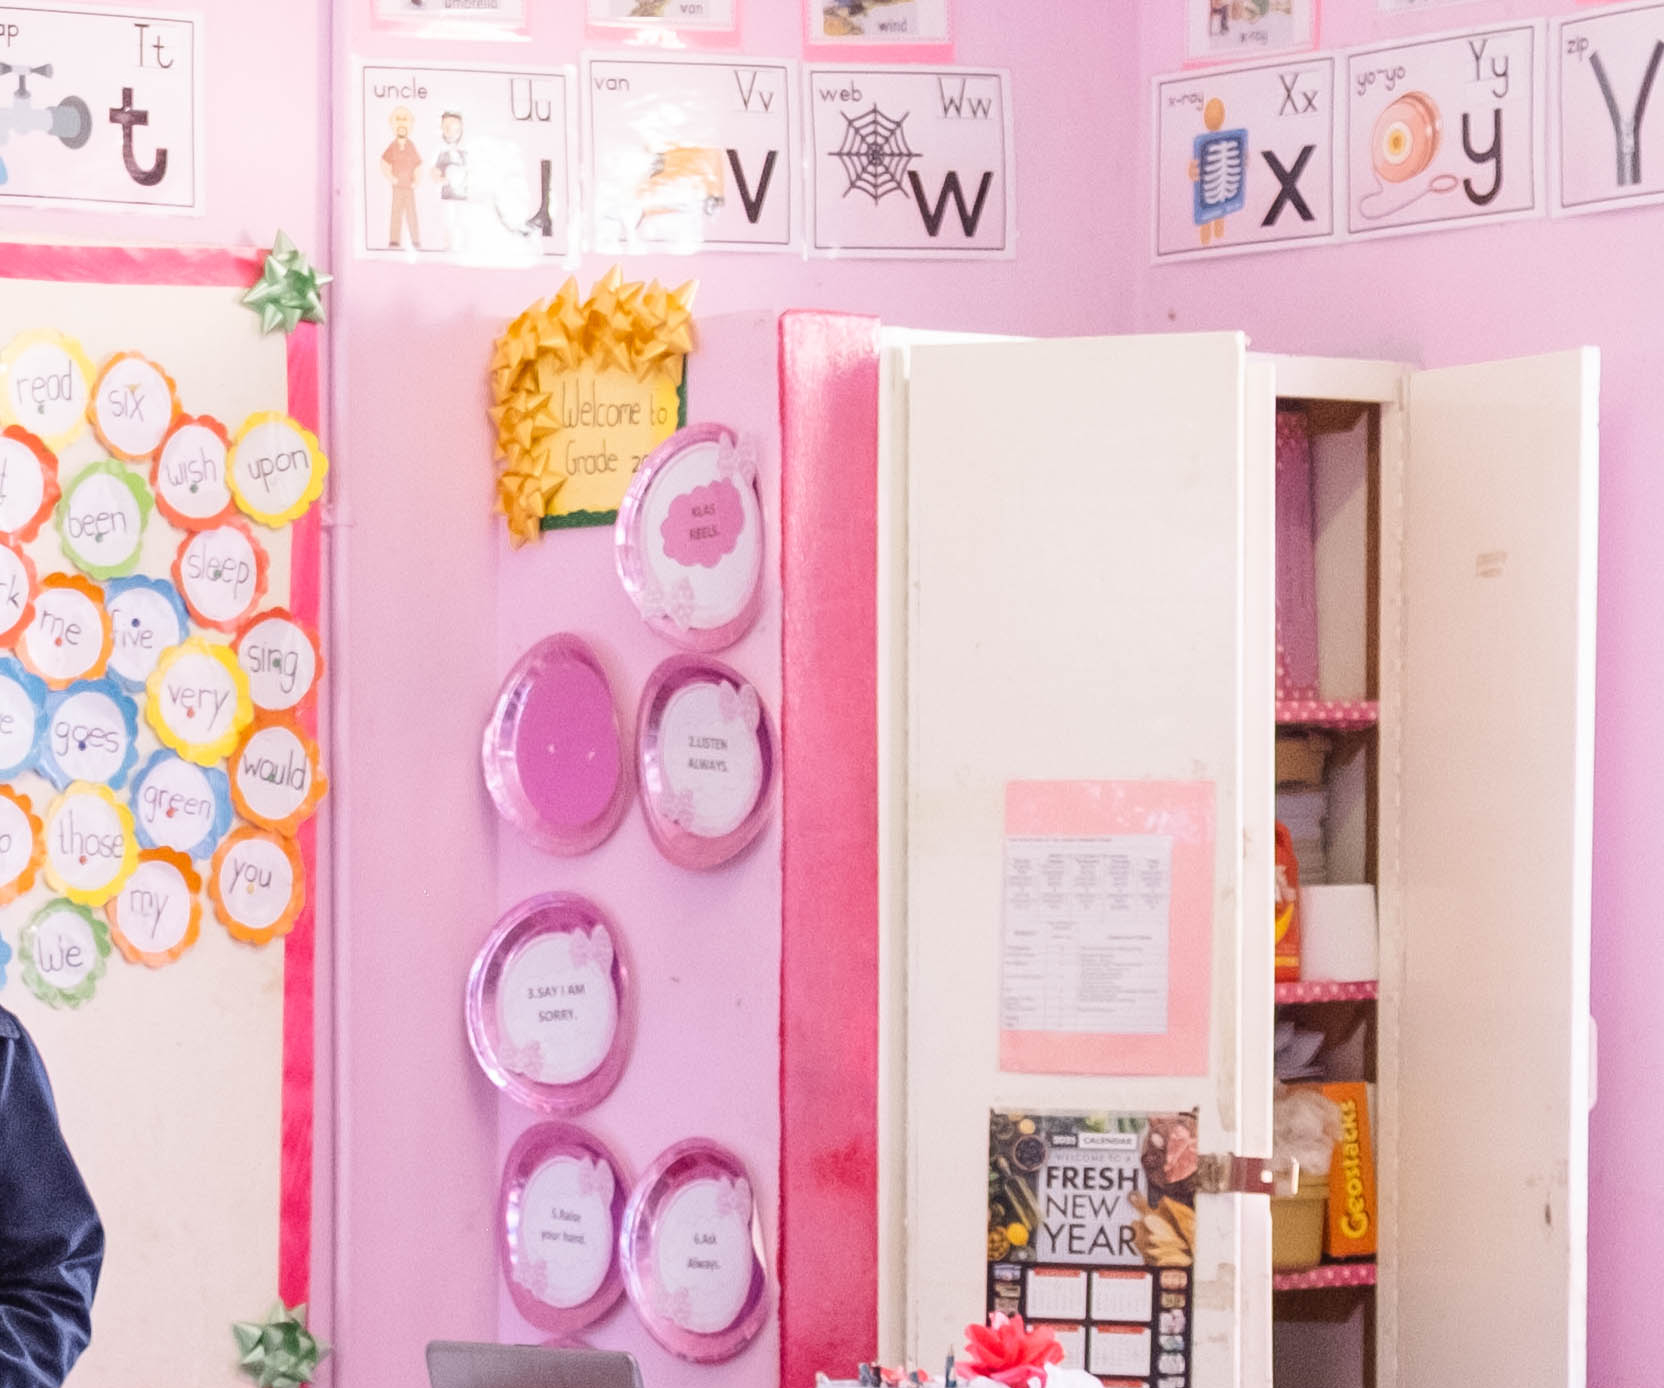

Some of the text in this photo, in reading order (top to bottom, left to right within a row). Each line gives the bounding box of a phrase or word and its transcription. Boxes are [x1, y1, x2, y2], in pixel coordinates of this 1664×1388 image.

[877, 17, 909, 34] wind
[134, 23, 174, 69] Tt
[1567, 35, 1590, 61] zip
[593, 74, 631, 92] van
[1356, 64, 1407, 96] yo-yo
[1470, 39, 1510, 98] Yy
[373, 81, 428, 101] uncle
[509, 77, 553, 123] Uu
[733, 70, 775, 113] Vv
[819, 82, 863, 103] web
[937, 76, 993, 120] Ww
[1279, 72, 1319, 117] Xx
[108, 86, 168, 186] t
[1462, 107, 1504, 206] y
[16, 360, 72, 404] read
[108, 389, 146, 422] six
[561, 378, 668, 429] Welcome to
[166, 447, 217, 487] wish
[248, 448, 310, 493] upon
[565, 439, 618, 475] Grade
[68, 509, 126, 538] been
[187, 543, 250, 600] sleep
[41, 609, 83, 646] me
[247, 643, 299, 694] sing
[168, 682, 230, 731] very
[54, 721, 120, 756] goes
[243, 750, 308, 791] would
[143, 785, 212, 823] green
[60, 810, 125, 859] those
[229, 857, 272, 894] you
[130, 889, 169, 939] my
[1045, 1165, 1140, 1191] FRESH
[1045, 1194, 1122, 1220] NEW
[1043, 1223, 1138, 1257] YEAR
